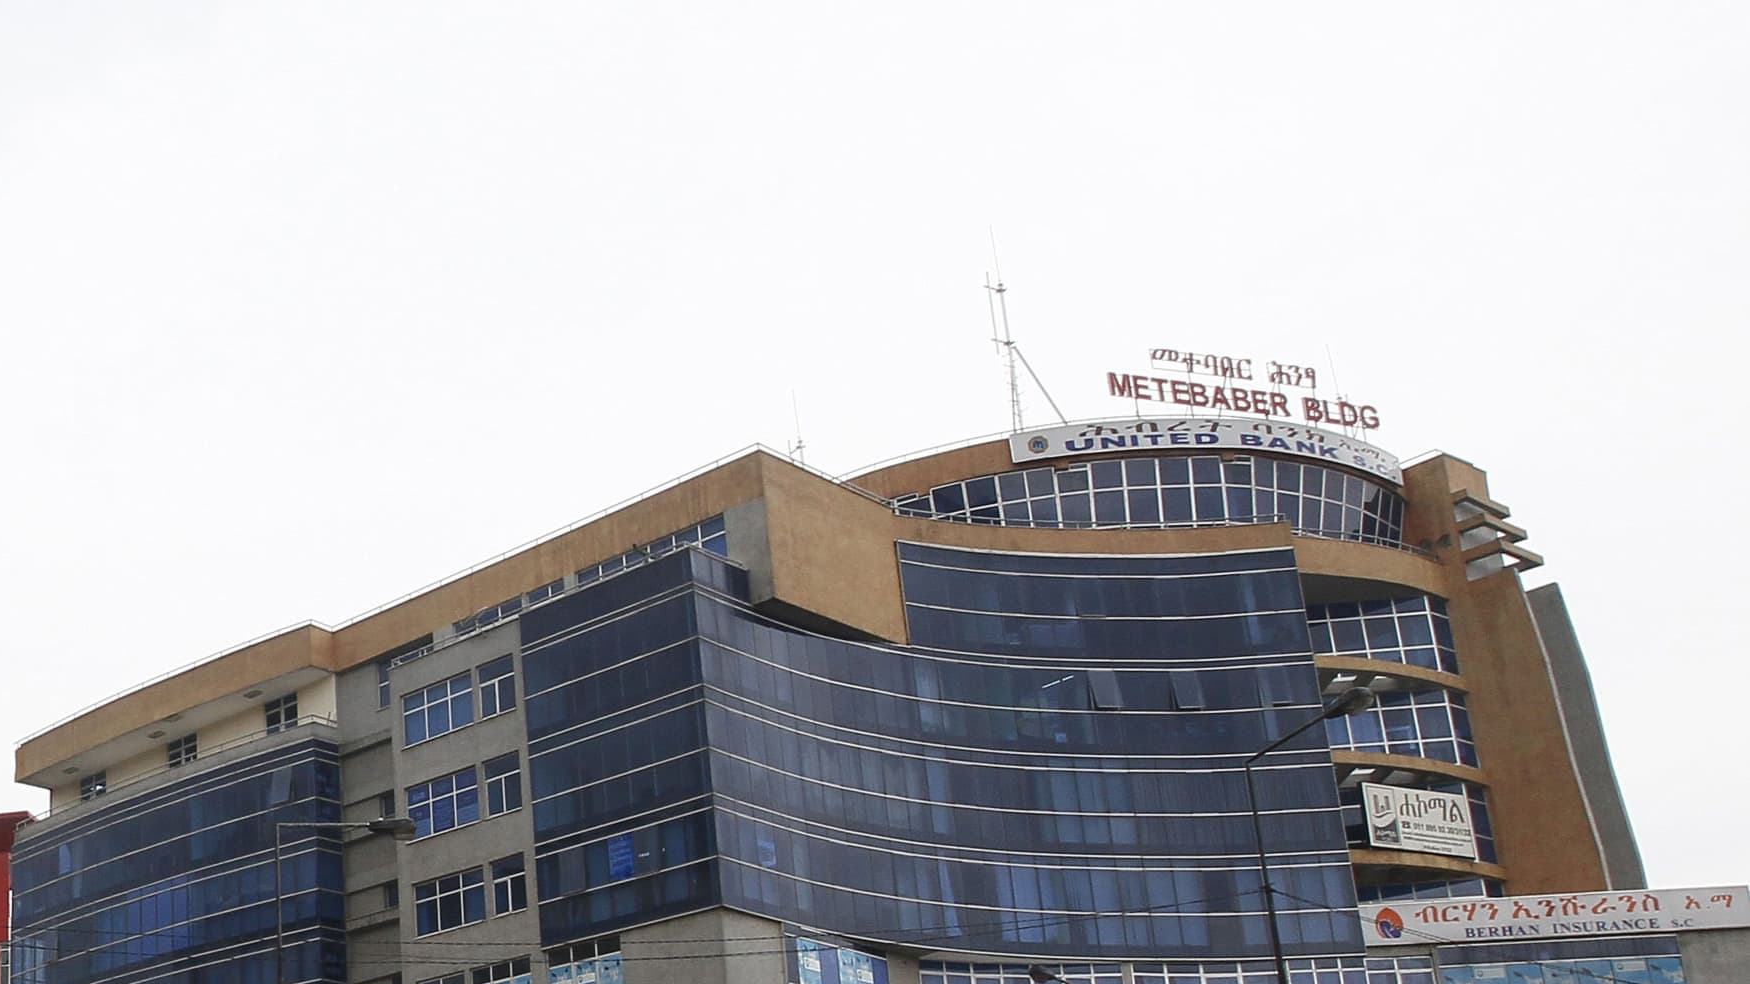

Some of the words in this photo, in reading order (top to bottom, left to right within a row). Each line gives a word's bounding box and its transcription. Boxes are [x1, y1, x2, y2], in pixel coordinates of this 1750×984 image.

[1151, 348, 1253, 380] መተባበር
[1107, 371, 1291, 418] METEBABER
[1302, 396, 1381, 430] BLDG
[1253, 423, 1325, 443] ባንክ
[1065, 433, 1220, 451] UNITED
[1240, 434, 1339, 459] BANK
[1353, 455, 1397, 480] S.C.
[1415, 903, 1499, 923] ብርሃን
[1513, 894, 1660, 920] ኢንሹራንስ
[1465, 924, 1540, 938] BERHAN
[1553, 918, 1660, 934] INSURANCE
